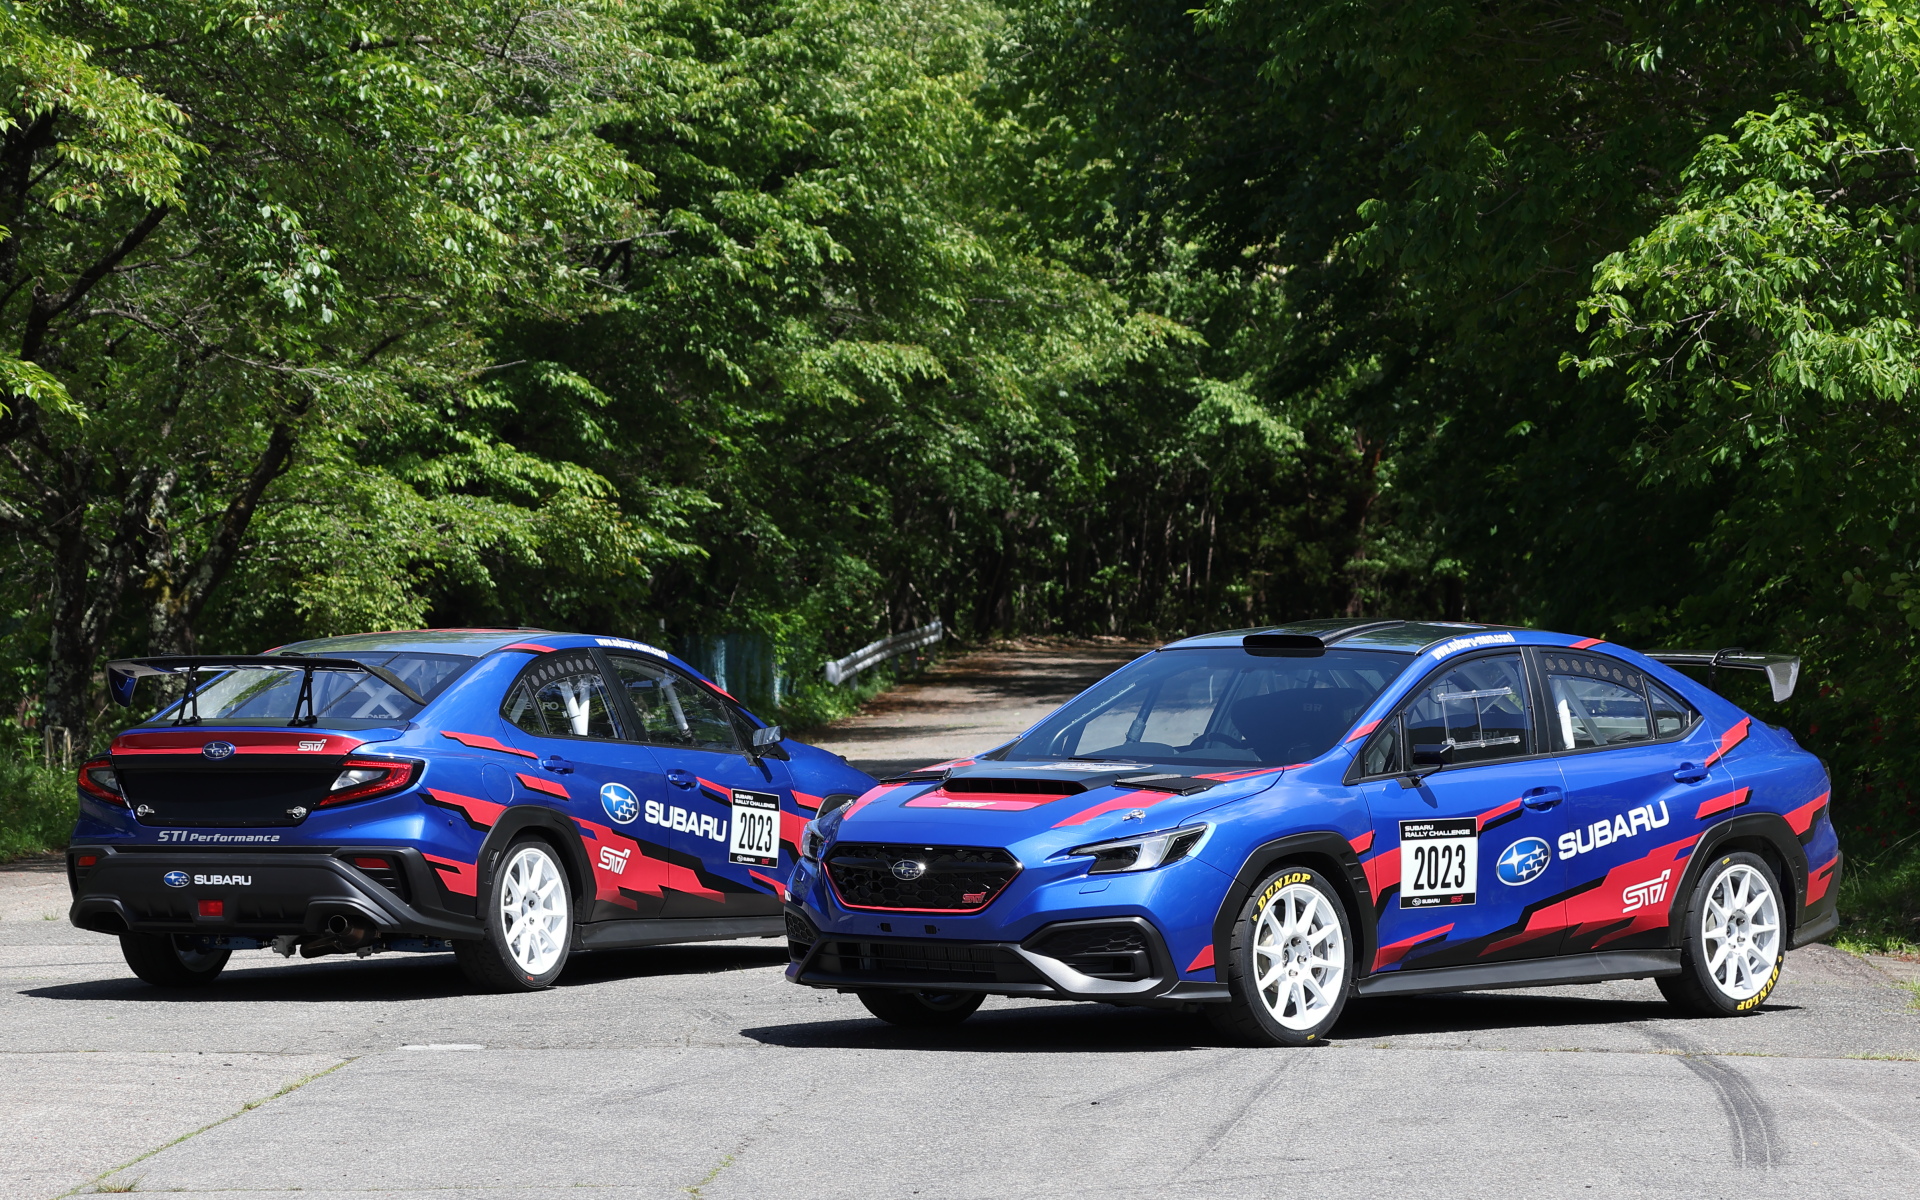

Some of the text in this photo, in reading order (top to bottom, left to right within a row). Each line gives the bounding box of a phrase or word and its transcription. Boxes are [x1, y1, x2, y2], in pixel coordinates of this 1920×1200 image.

[157, 830, 281, 843] STI Performance
[644, 799, 728, 843] SUBARU
[738, 811, 773, 853] 2023
[1404, 824, 1434, 832] SUBARU
[1428, 828, 1471, 837] CHALLENGE
[1557, 799, 1670, 861] SUBARU
[193, 874, 252, 886] SUBARU
[1413, 843, 1466, 891] 2023
[1257, 872, 1312, 913] DUNLOP
[1736, 964, 1780, 1011] DUNLOP
